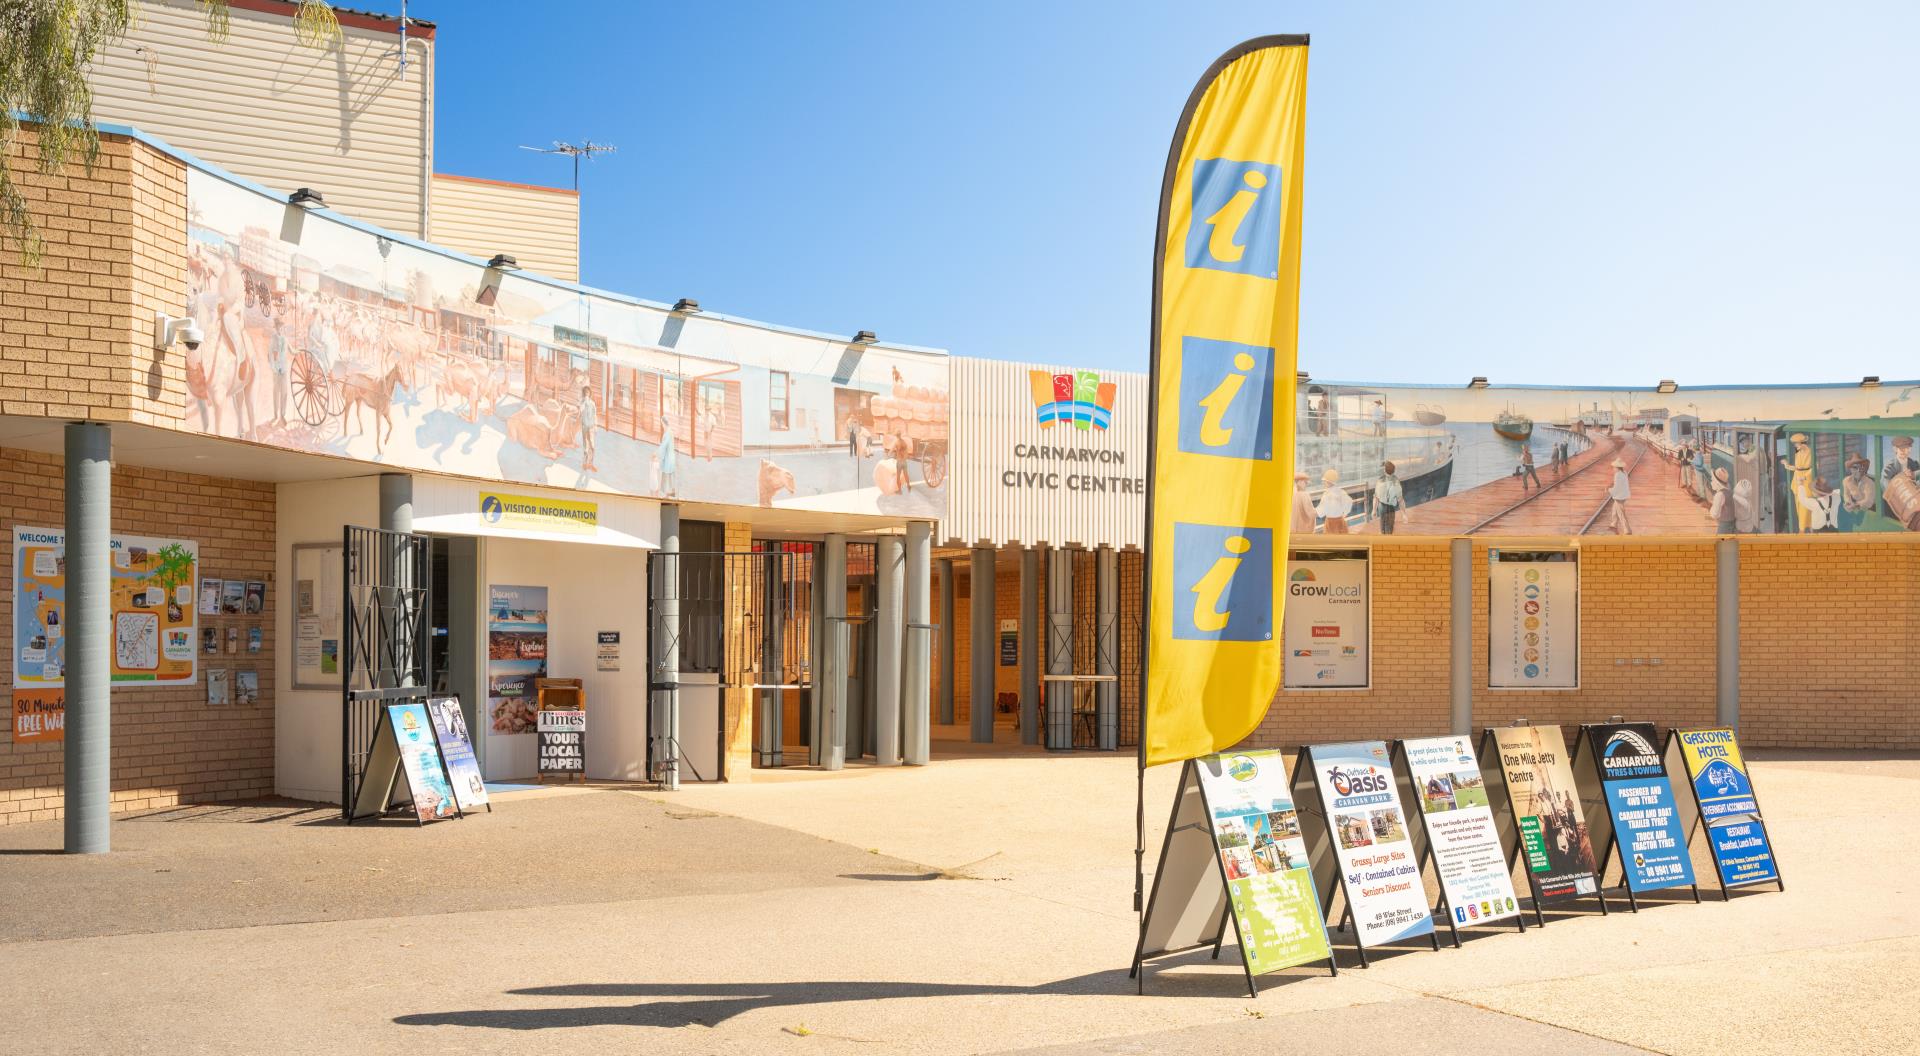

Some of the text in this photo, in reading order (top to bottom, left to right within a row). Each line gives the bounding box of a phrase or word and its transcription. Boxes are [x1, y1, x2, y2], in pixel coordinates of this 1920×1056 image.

[1014, 443, 1125, 465] CARNARVON
[1001, 470, 1144, 495] CIVIC CENTRE
[504, 503, 537, 514] VISITOR
[539, 506, 596, 520] INFORMATION
[19, 533, 58, 544] WELCOME
[492, 589, 519, 599] Discover
[521, 641, 545, 652] Explore
[491, 681, 526, 692] Experience
[17, 699, 30, 713] 30
[17, 714, 41, 732] FREE
[539, 711, 584, 725] Times
[543, 733, 579, 744] YOUR
[1683, 731, 1733, 745] GASCOYNE
[541, 746, 581, 757] LOCAL
[1413, 748, 1425, 757] great
[1426, 746, 1438, 756] place
[1697, 745, 1729, 759] HOTEL
[540, 758, 582, 770] PAPER
[1504, 752, 1555, 766] One Mile Jetty
[1603, 754, 1660, 768] CARNARVON
[1508, 771, 1534, 783] Centre
[1606, 766, 1662, 777] TYRES & TOWING
[1333, 772, 1388, 797] Oasis
[1618, 786, 1662, 798] PASSENGER AND
[1338, 794, 1388, 807] CARAVAN PARK
[1641, 795, 1659, 805] TYRES
[1618, 807, 1672, 821] CARAVAN AND BOAT
[1627, 817, 1668, 829] TRAILER TYRES
[1636, 830, 1667, 841] TRUCK AND
[1632, 838, 1675, 851] TRACTOR TYRES
[1351, 852, 1406, 867] Grassy Large Sites
[1348, 873, 1361, 885] Self
[1365, 868, 1395, 881] Contained
[1396, 864, 1416, 876] Cabins
[1646, 866, 1655, 876] 08
[1362, 882, 1411, 897] Seniors Discount
[1383, 910, 1396, 918] Wise
[1396, 907, 1412, 915] Street
[1366, 921, 1385, 931] Phone:
